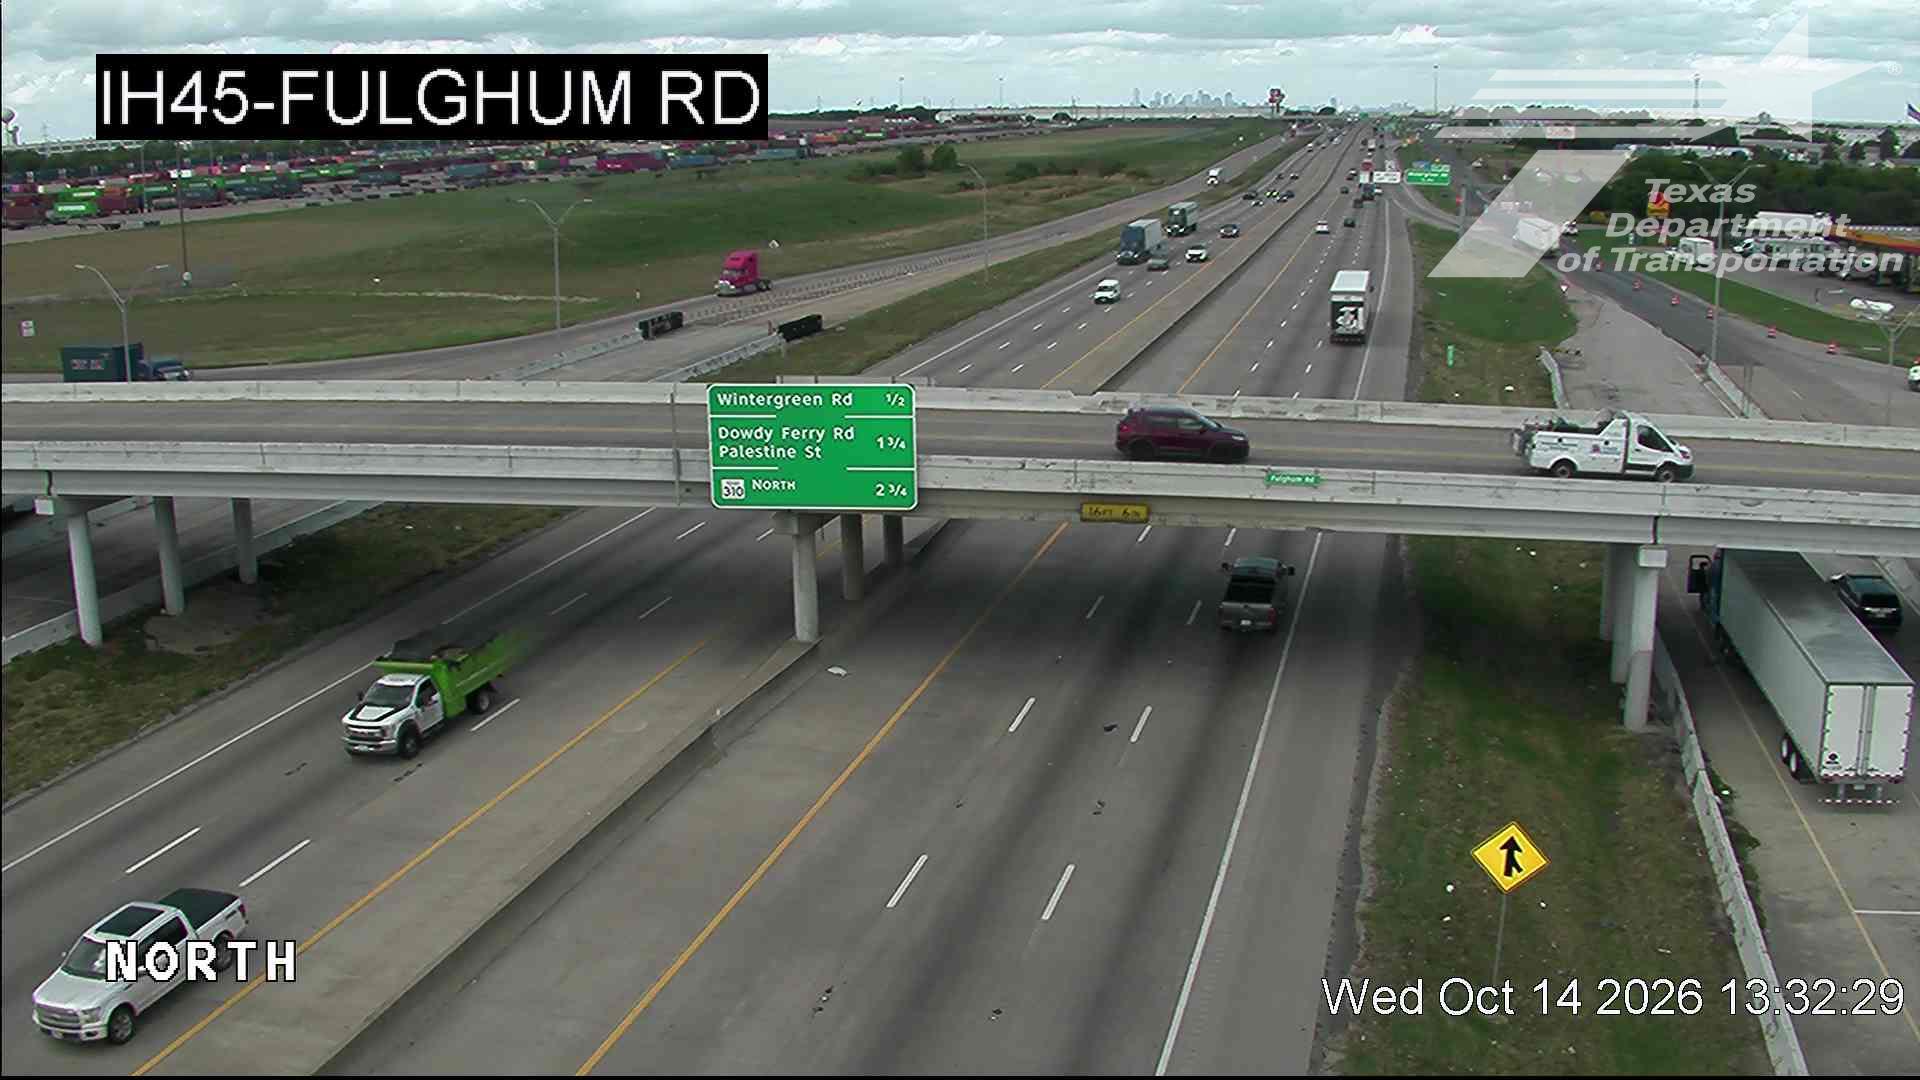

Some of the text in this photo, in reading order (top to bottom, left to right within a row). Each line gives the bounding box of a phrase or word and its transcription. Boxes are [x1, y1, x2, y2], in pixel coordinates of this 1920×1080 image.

[717, 393, 853, 409] Wintergreen Rd
[718, 426, 855, 444] Dowdy Ferry Rd
[719, 445, 822, 459] Palestine St
[724, 486, 744, 497] 310
